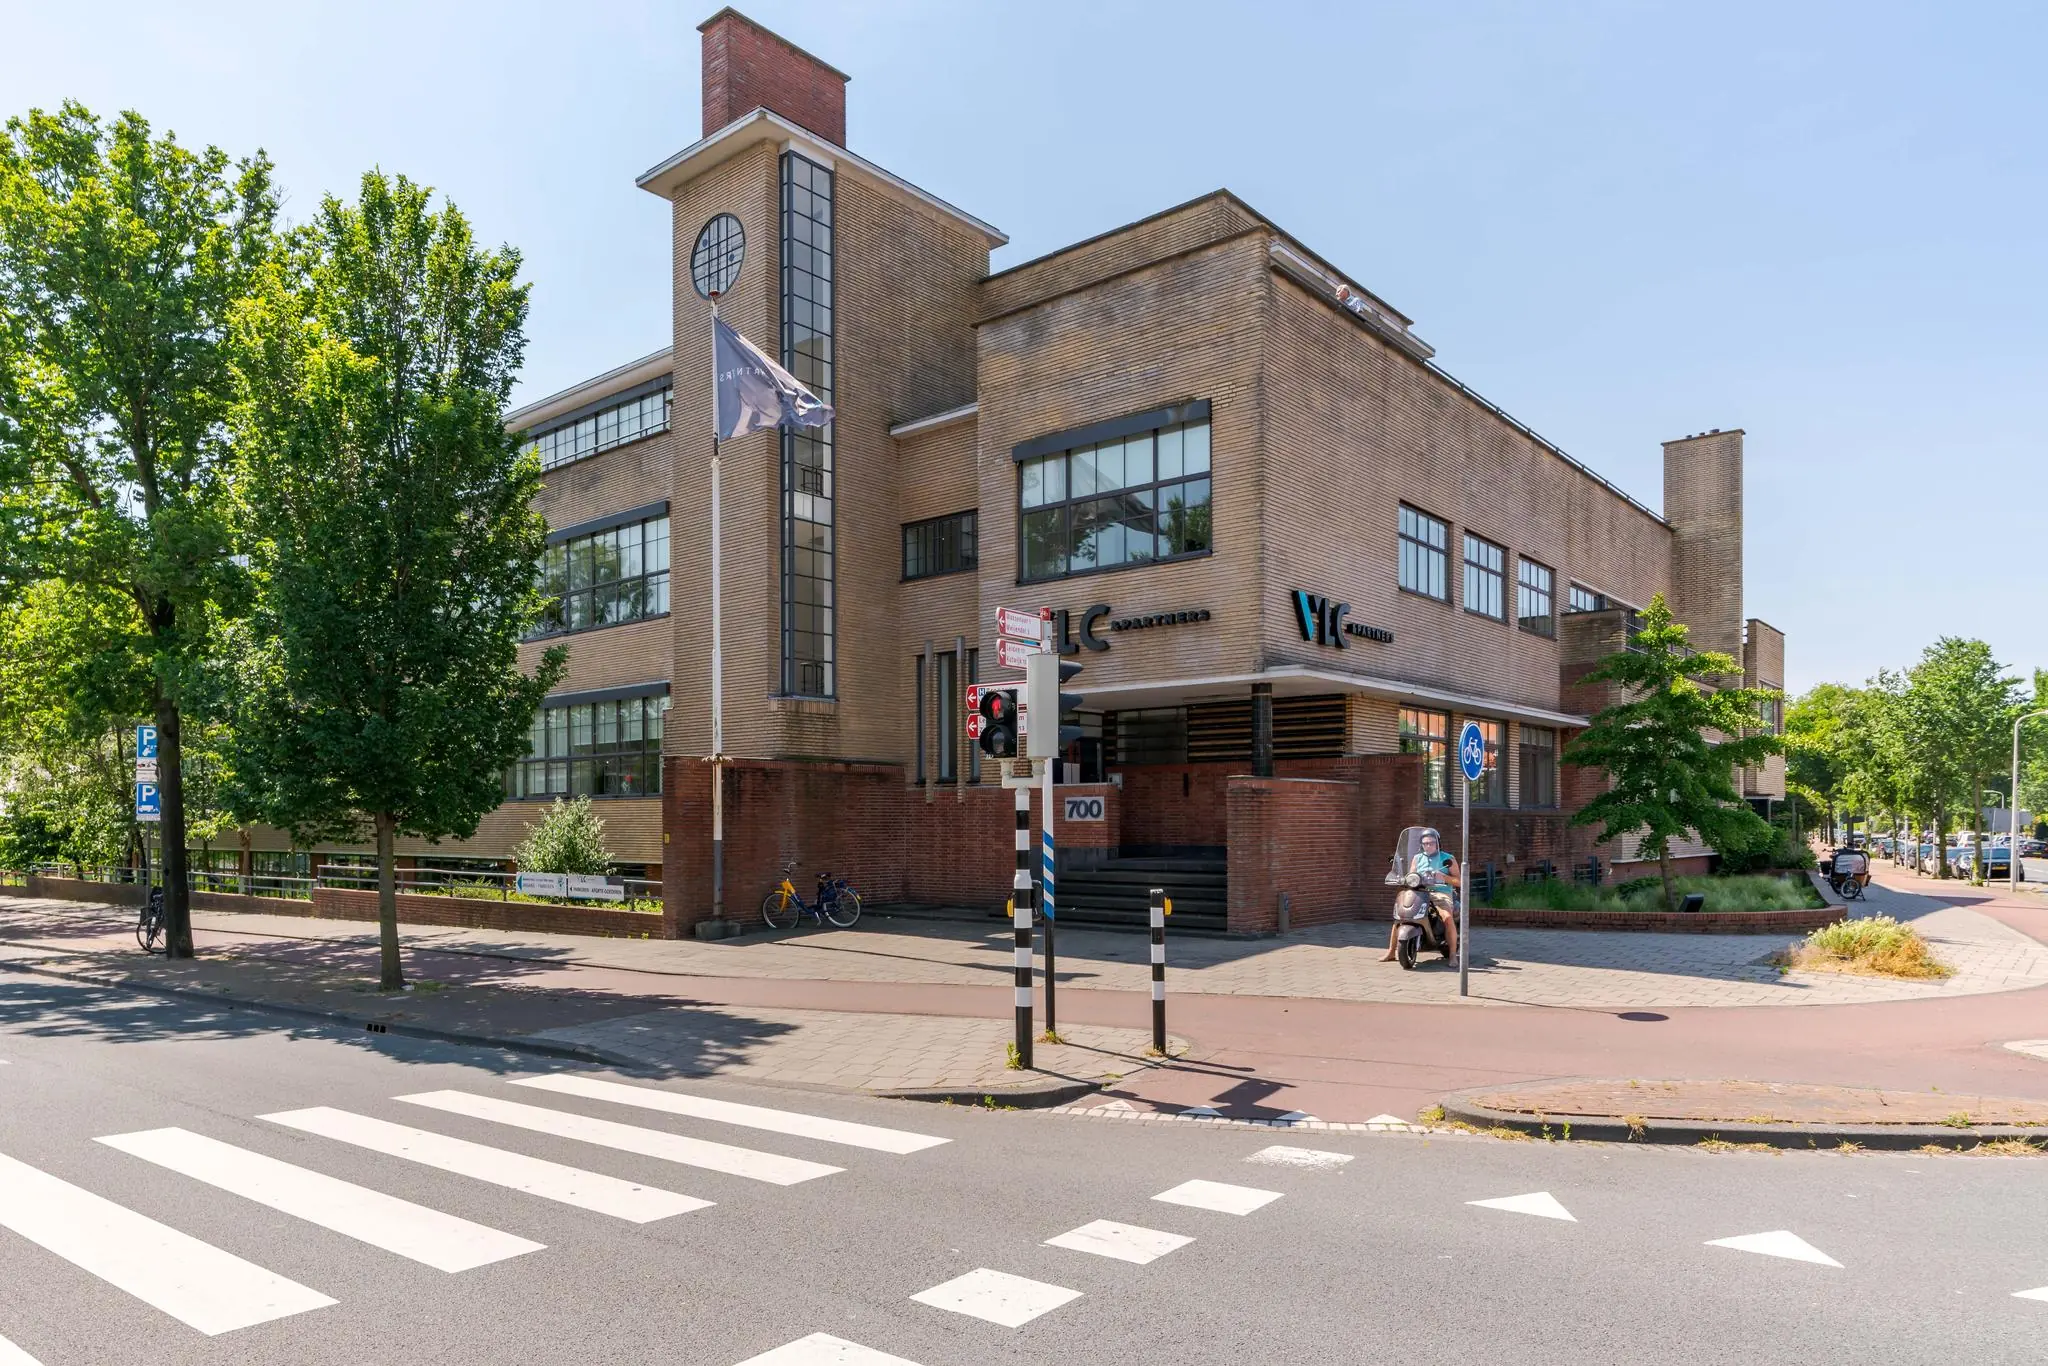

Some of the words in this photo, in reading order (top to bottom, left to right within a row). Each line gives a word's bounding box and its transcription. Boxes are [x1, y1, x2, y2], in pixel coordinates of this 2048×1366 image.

[1040, 604, 1111, 655] LC
[1292, 590, 1351, 649] VLC
[143, 729, 157, 745] P
[142, 785, 156, 801] P
[1066, 799, 1102, 819] 700
